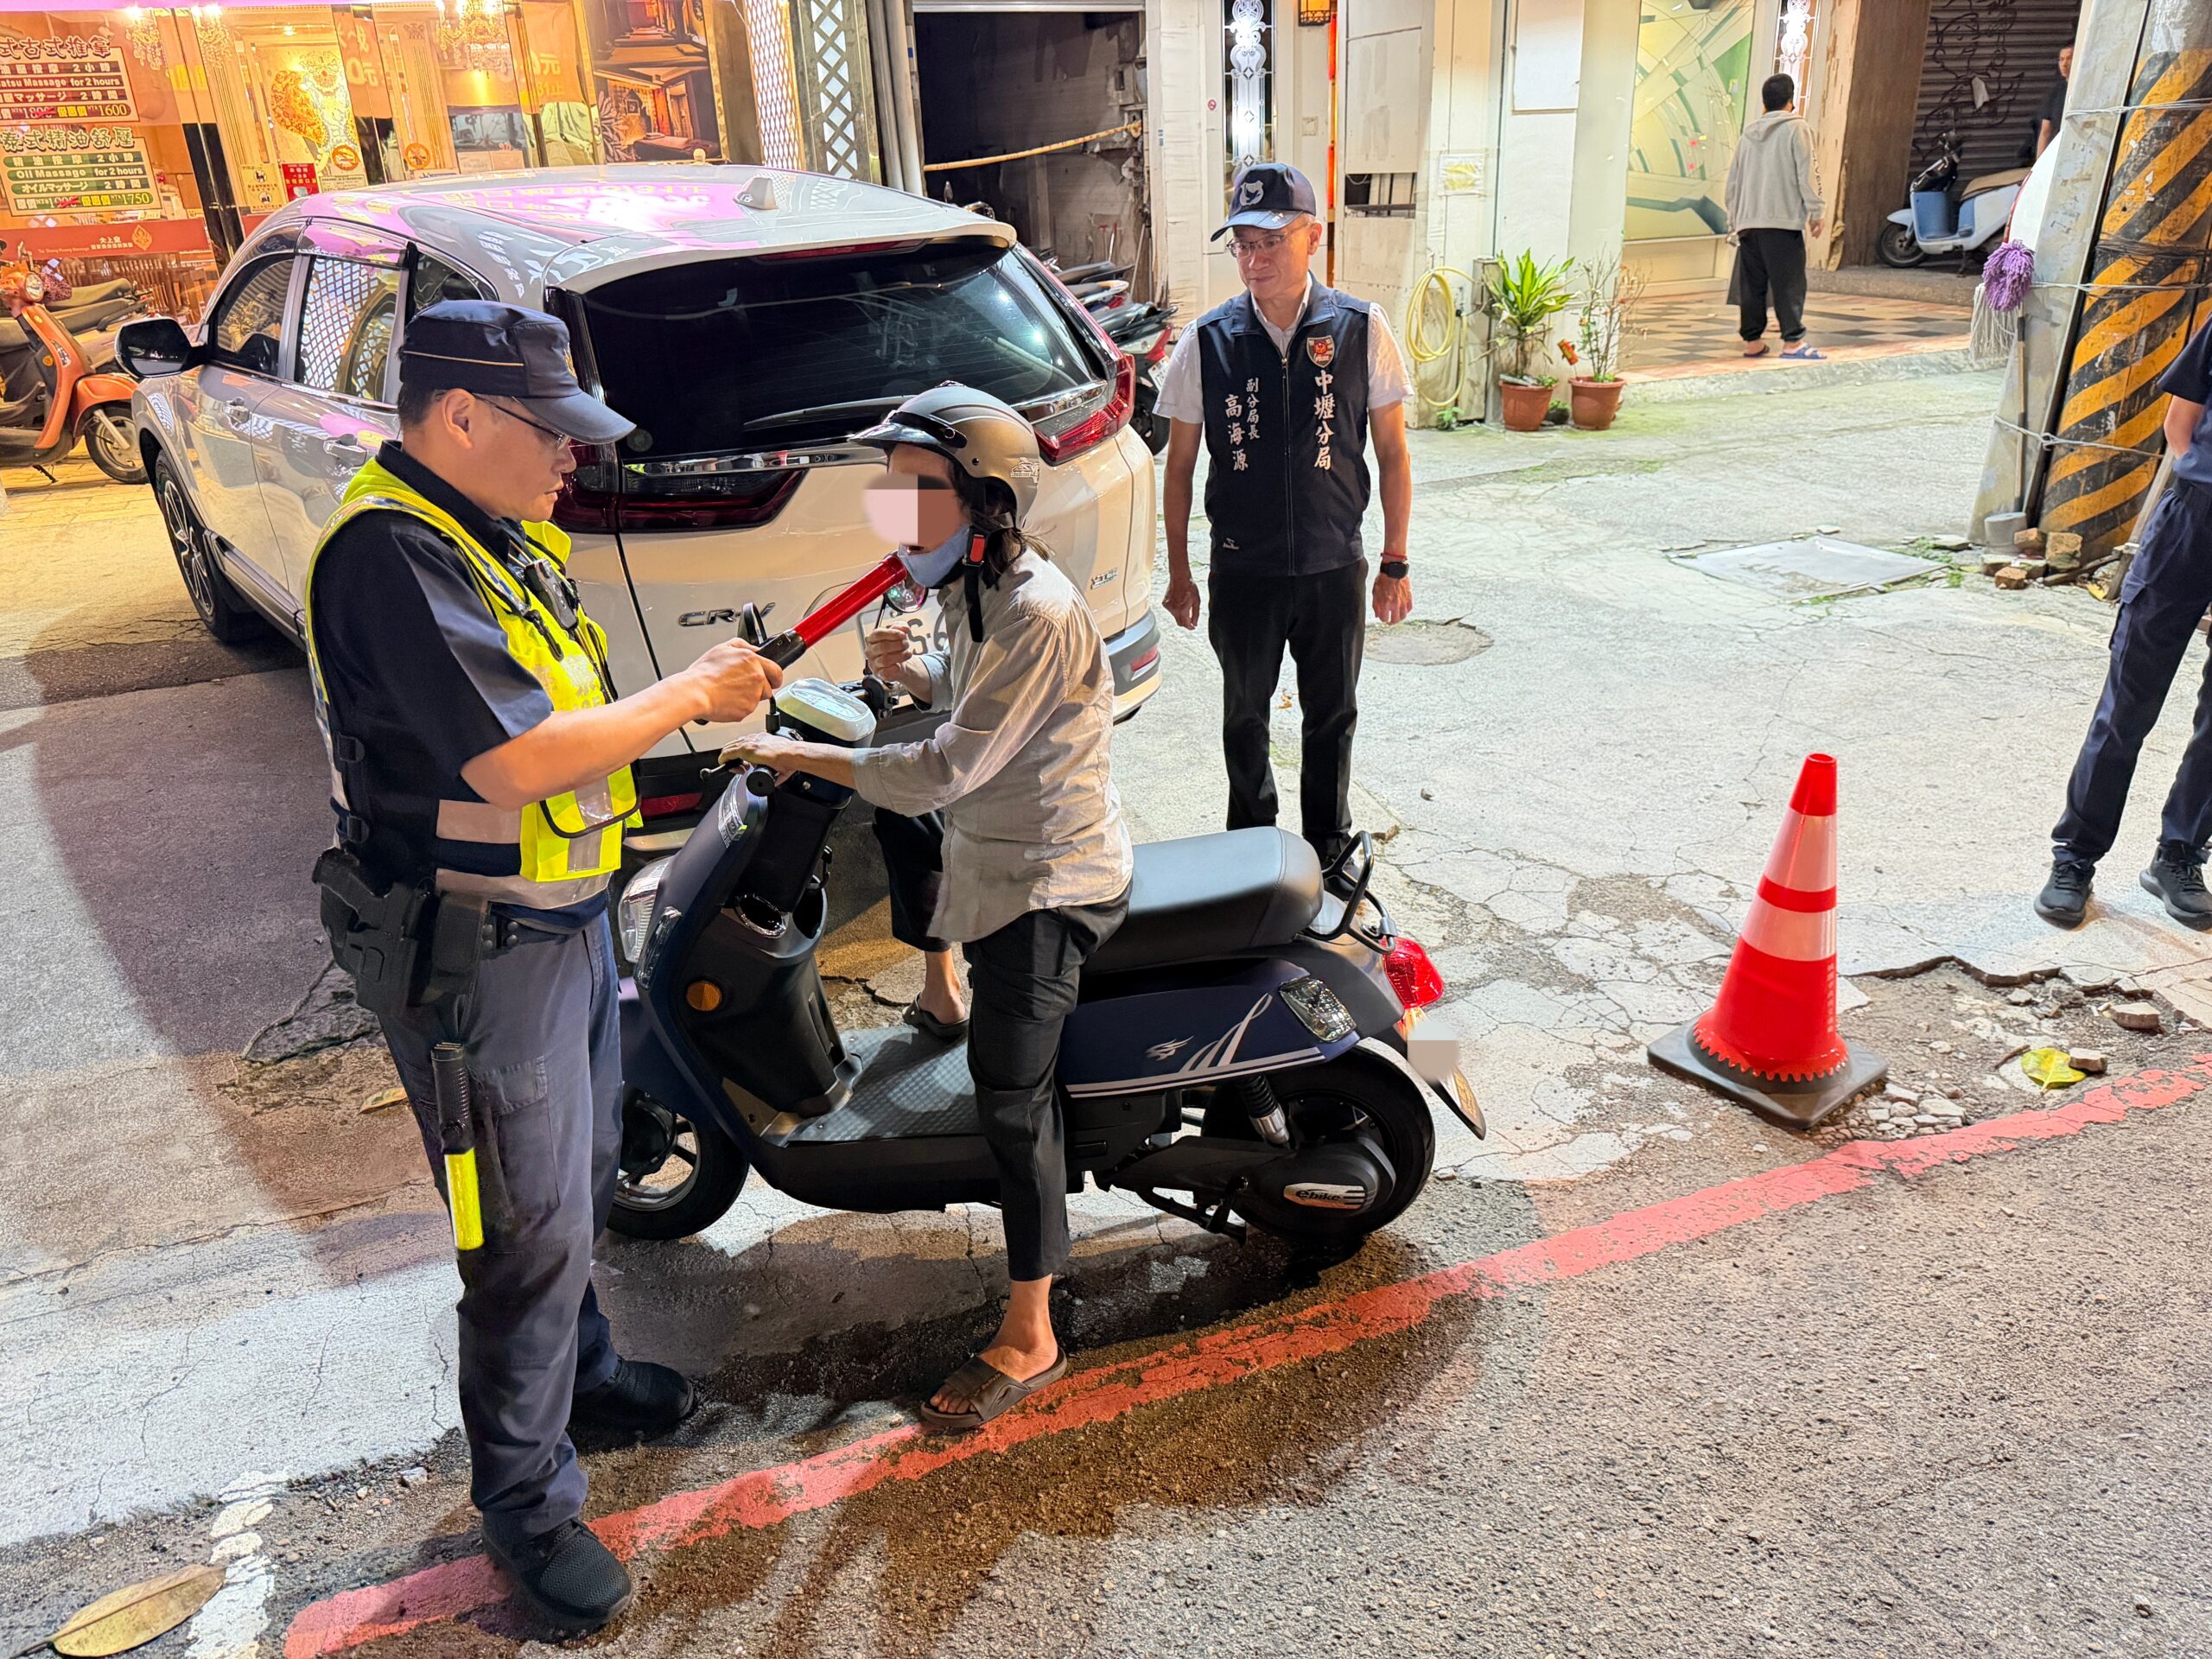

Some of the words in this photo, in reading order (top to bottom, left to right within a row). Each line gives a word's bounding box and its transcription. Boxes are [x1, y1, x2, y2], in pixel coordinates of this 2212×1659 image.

[23, 78, 67, 87] Massage
[70, 78, 84, 86] for
[93, 77, 120, 86] hours
[1, 127, 134, 152] 泰式精油舒壓
[16, 170, 33, 179] Oil
[35, 168, 86, 180] Massage
[22, 181, 88, 194] オイルマッサージ
[1246, 378, 1260, 441] 副分局長
[1313, 370, 1336, 470] 中壢分局
[1224, 394, 1249, 471] 高海源
[1295, 1190, 1341, 1201] ebike
